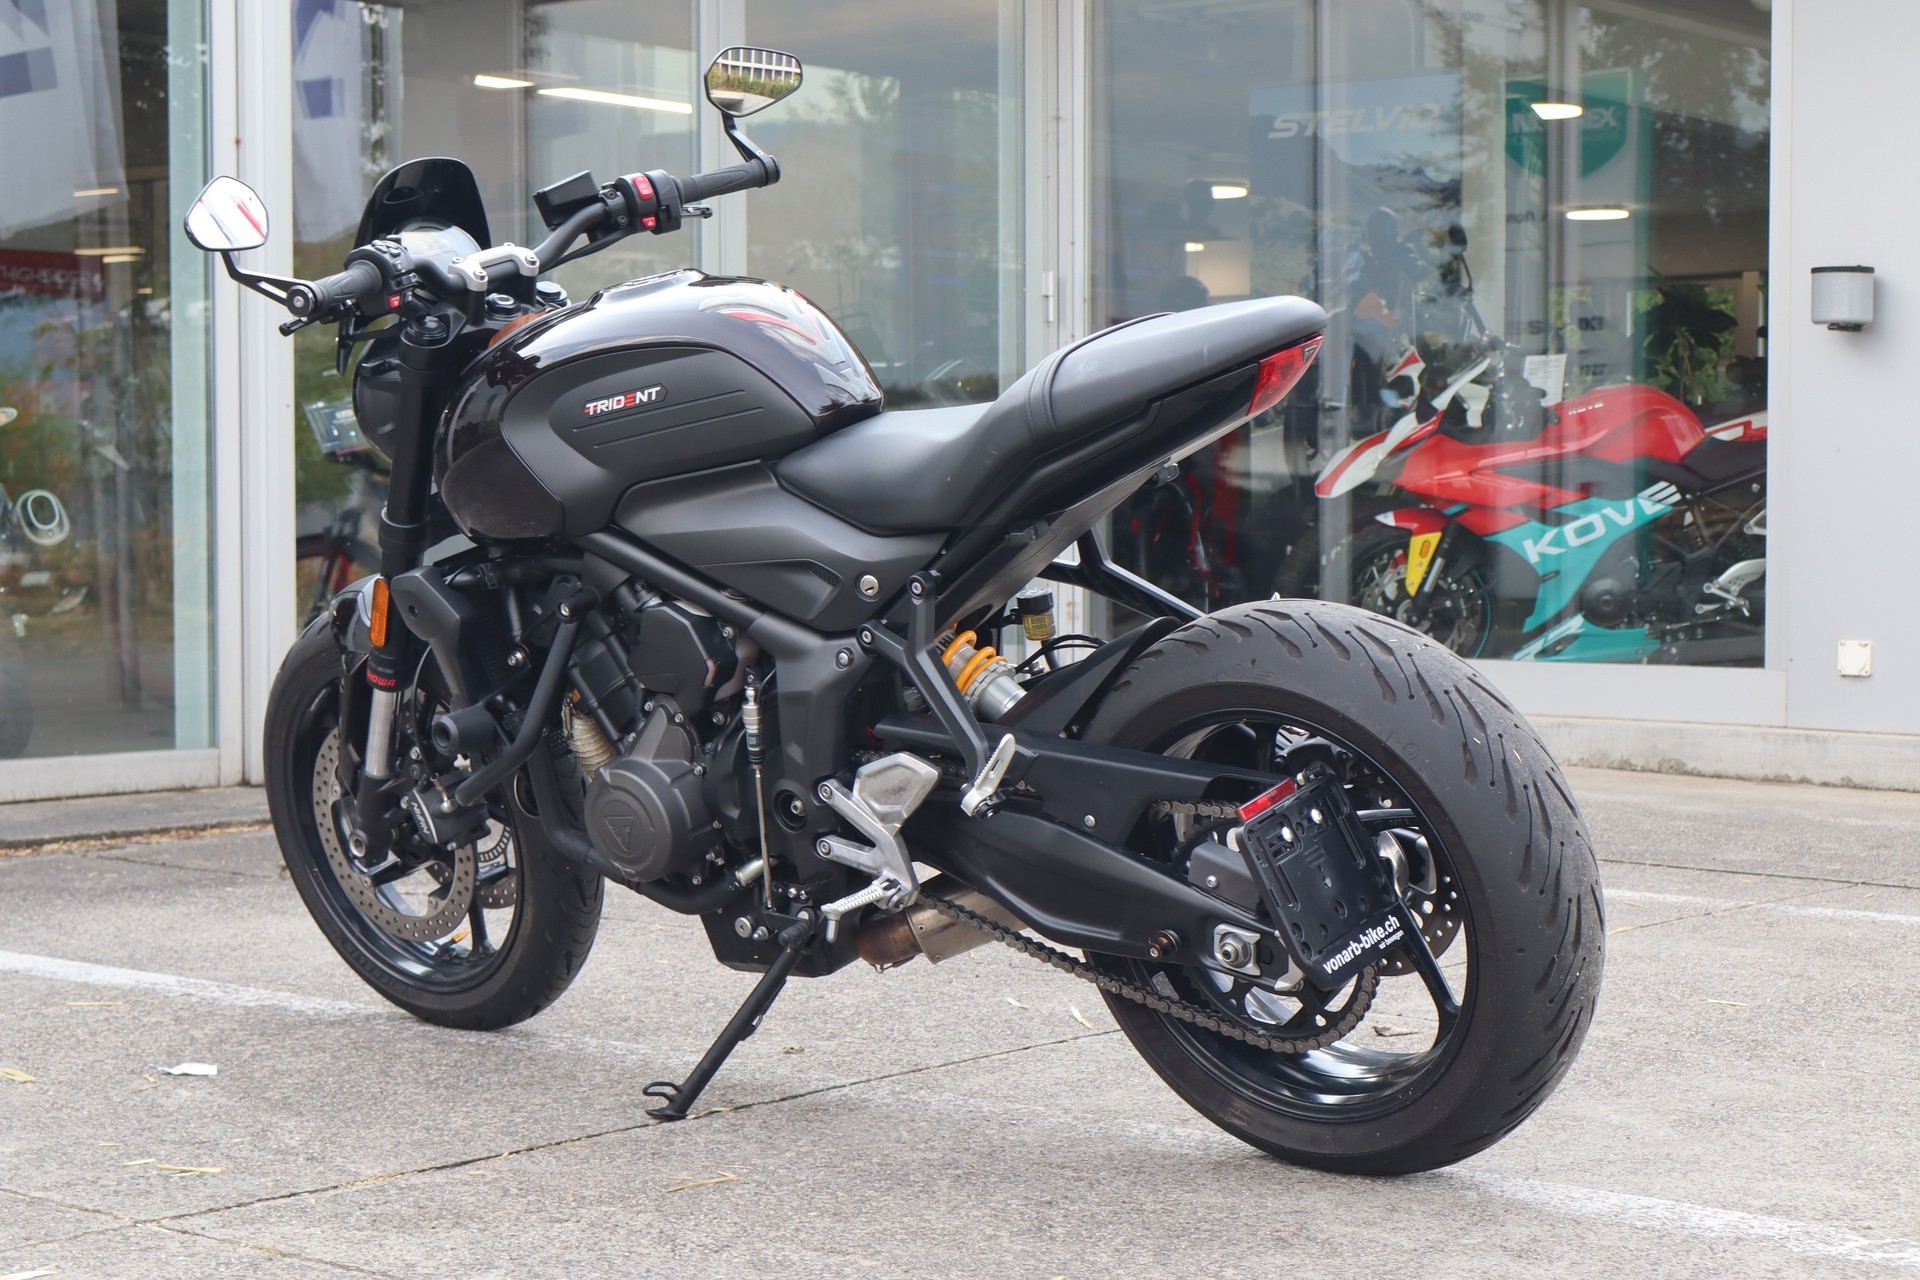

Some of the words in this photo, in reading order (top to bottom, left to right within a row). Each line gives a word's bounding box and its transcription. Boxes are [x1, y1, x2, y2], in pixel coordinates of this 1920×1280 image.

[584, 386, 661, 416] TRIDENT
[1522, 480, 1682, 564] KOVE
[1323, 914, 1400, 975] vonarb-bike.ch
